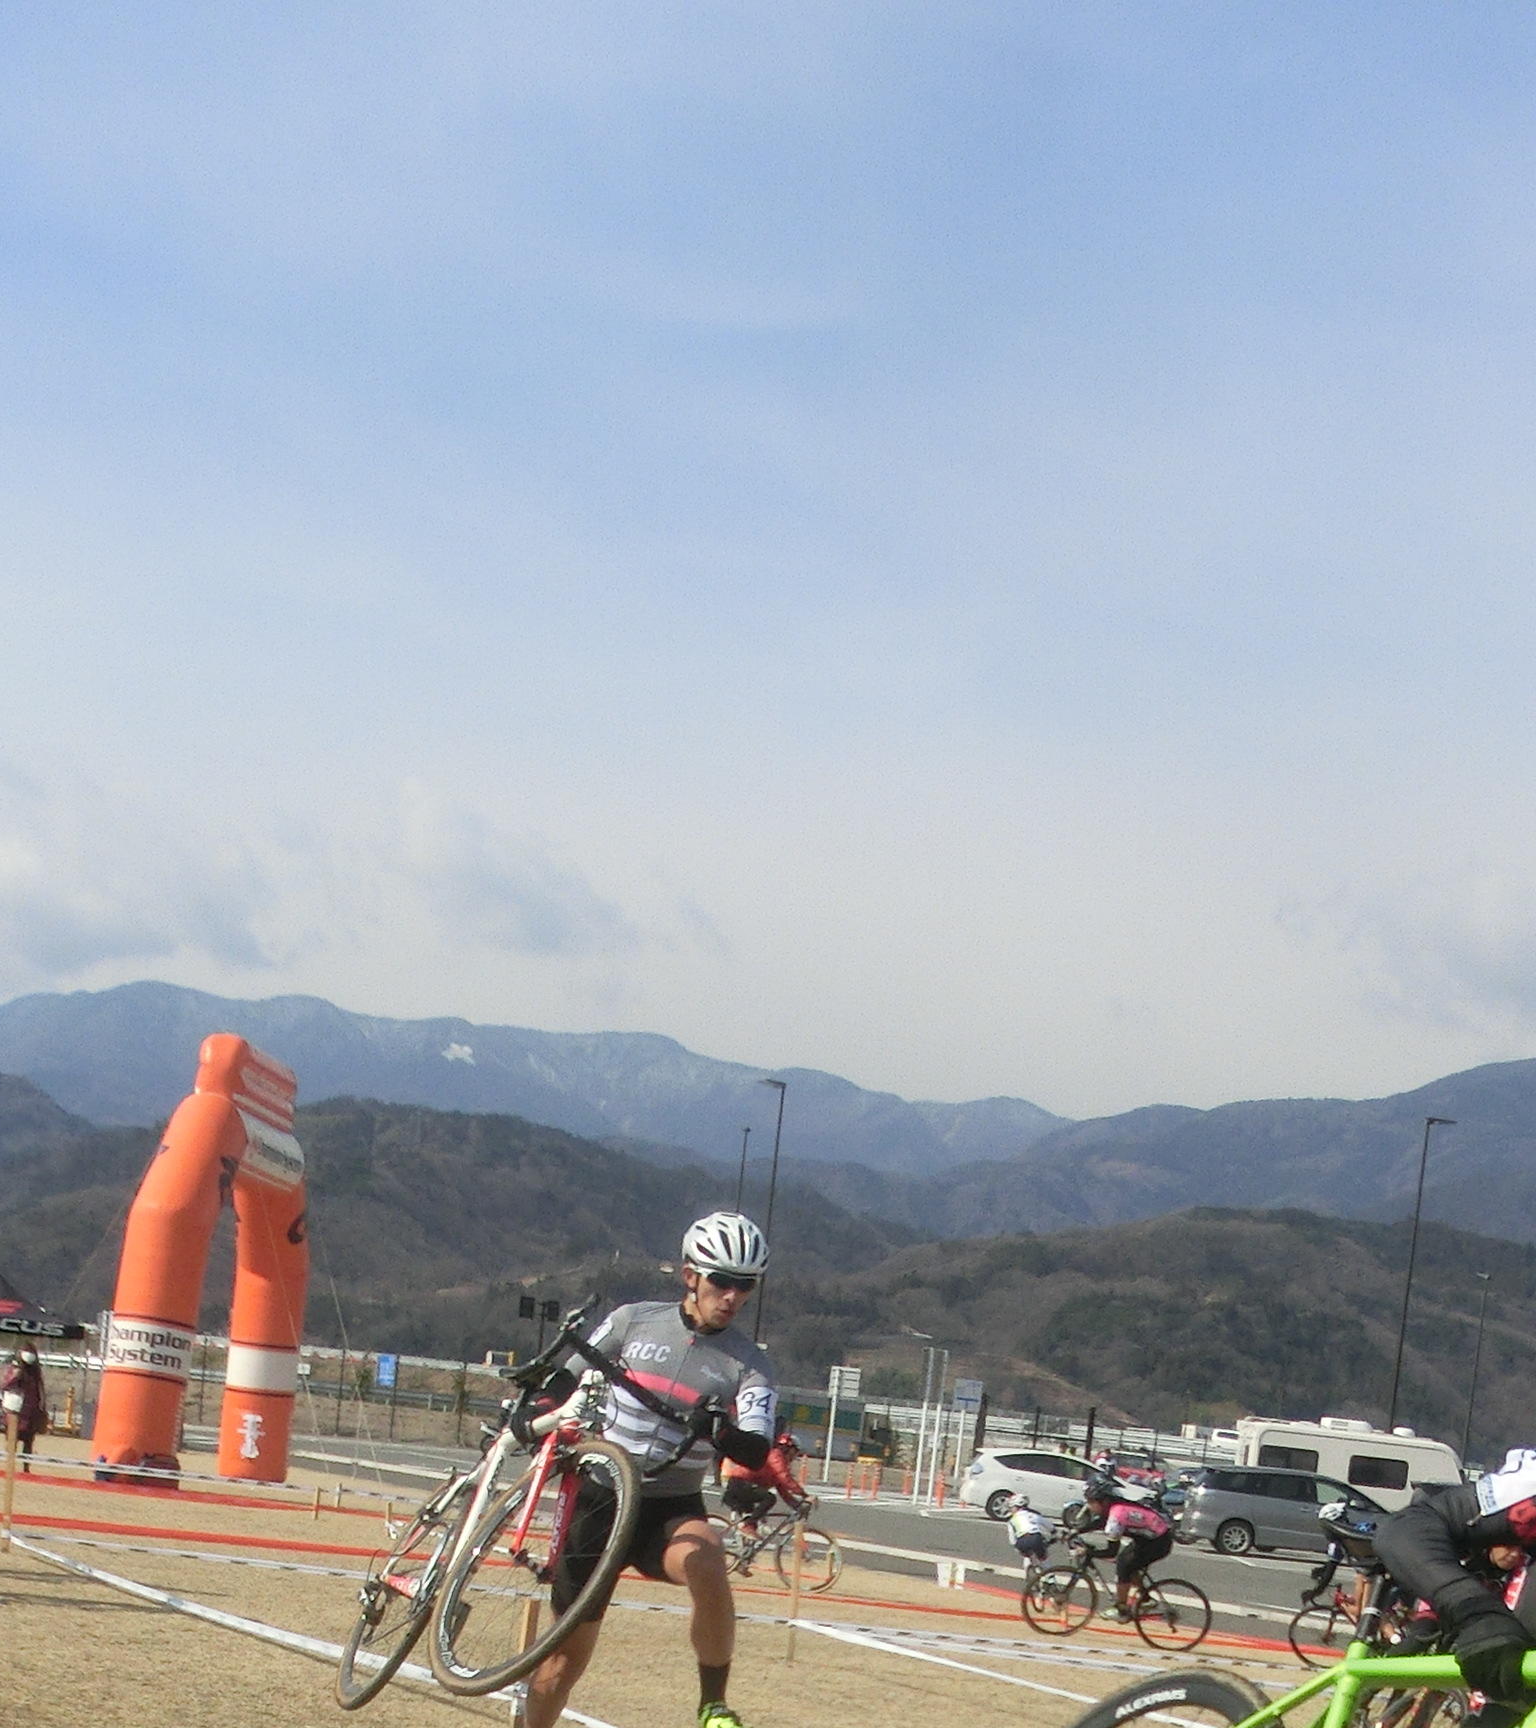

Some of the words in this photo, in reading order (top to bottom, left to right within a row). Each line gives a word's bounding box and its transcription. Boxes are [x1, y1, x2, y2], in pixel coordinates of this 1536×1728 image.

[112, 1324, 192, 1352] ampion
[622, 1341, 672, 1363] RCC
[740, 1391, 772, 1415] 34
